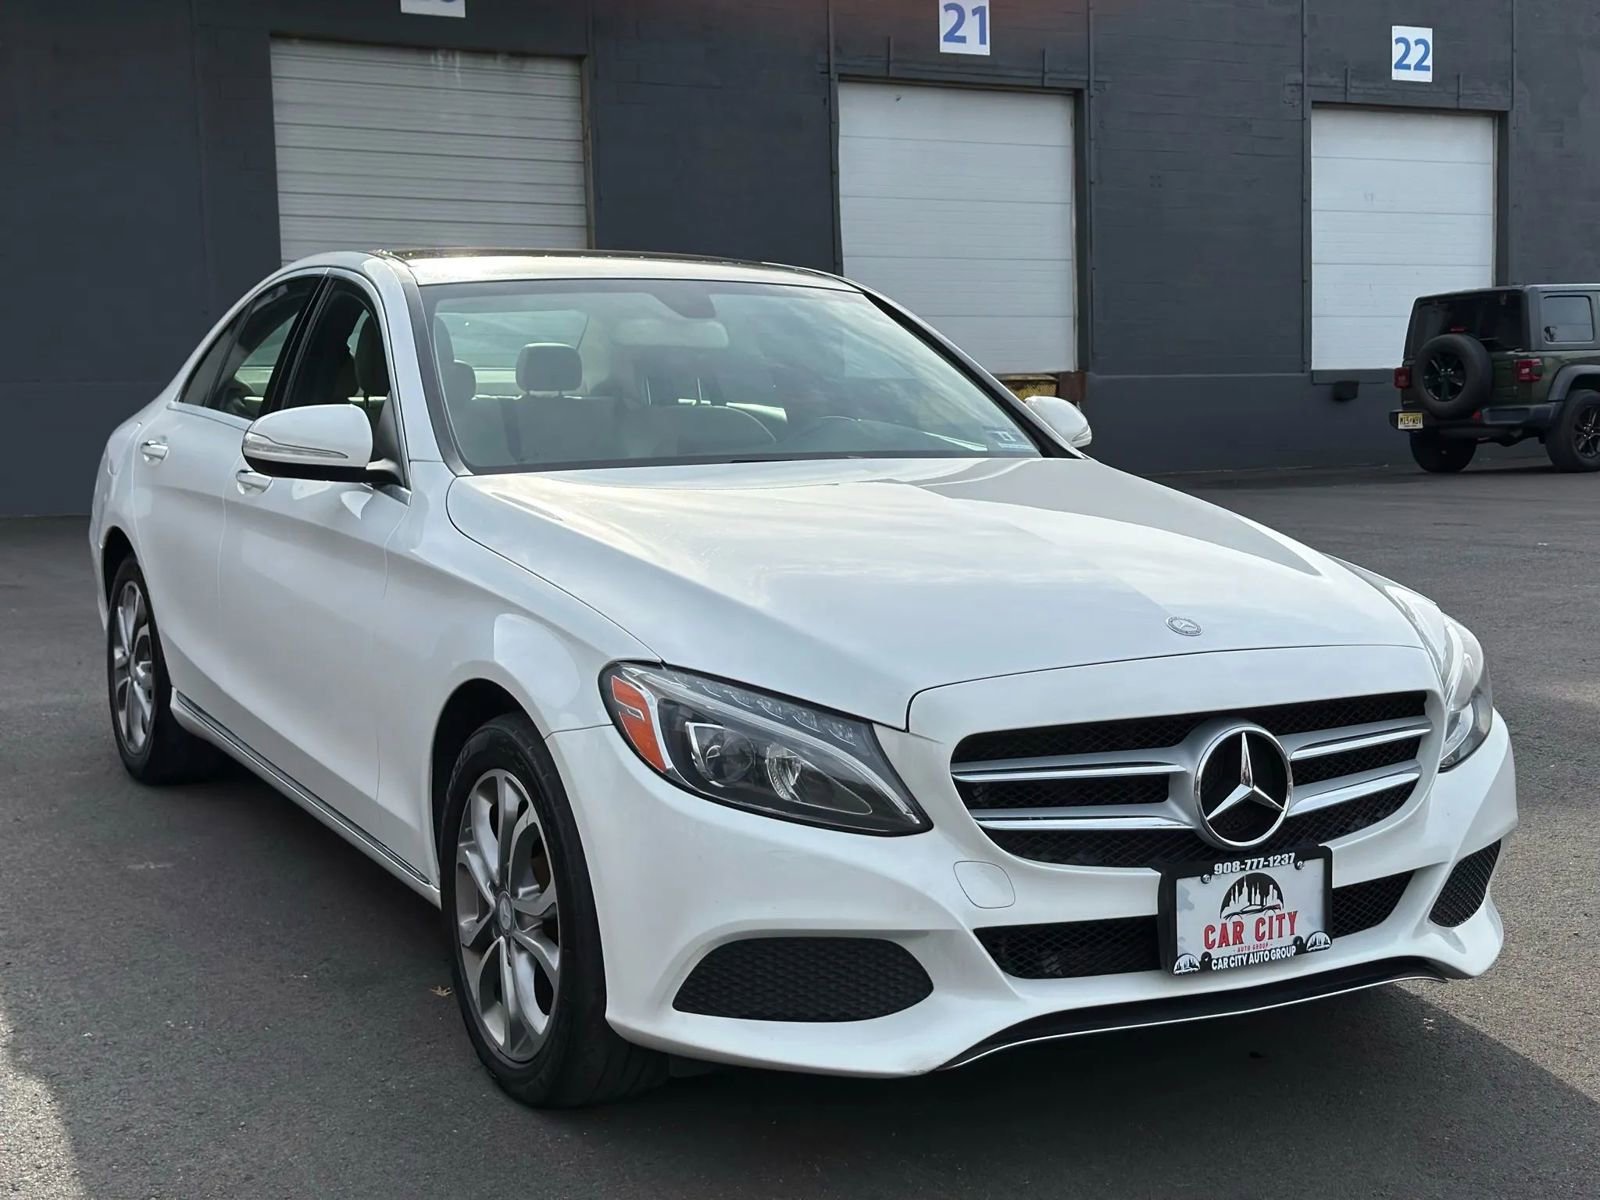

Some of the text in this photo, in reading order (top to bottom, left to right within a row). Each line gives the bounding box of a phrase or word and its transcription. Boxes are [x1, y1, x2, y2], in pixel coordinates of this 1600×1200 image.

[943, 2, 987, 45] 21
[1394, 36, 1431, 71] 22
[1213, 852, 1296, 875] 908-777-1237
[1203, 910, 1299, 950] CAR CITY
[1211, 945, 1297, 970] CAR CITY AUTO GROUP
[1237, 942, 1269, 953] AUTO GROUP
